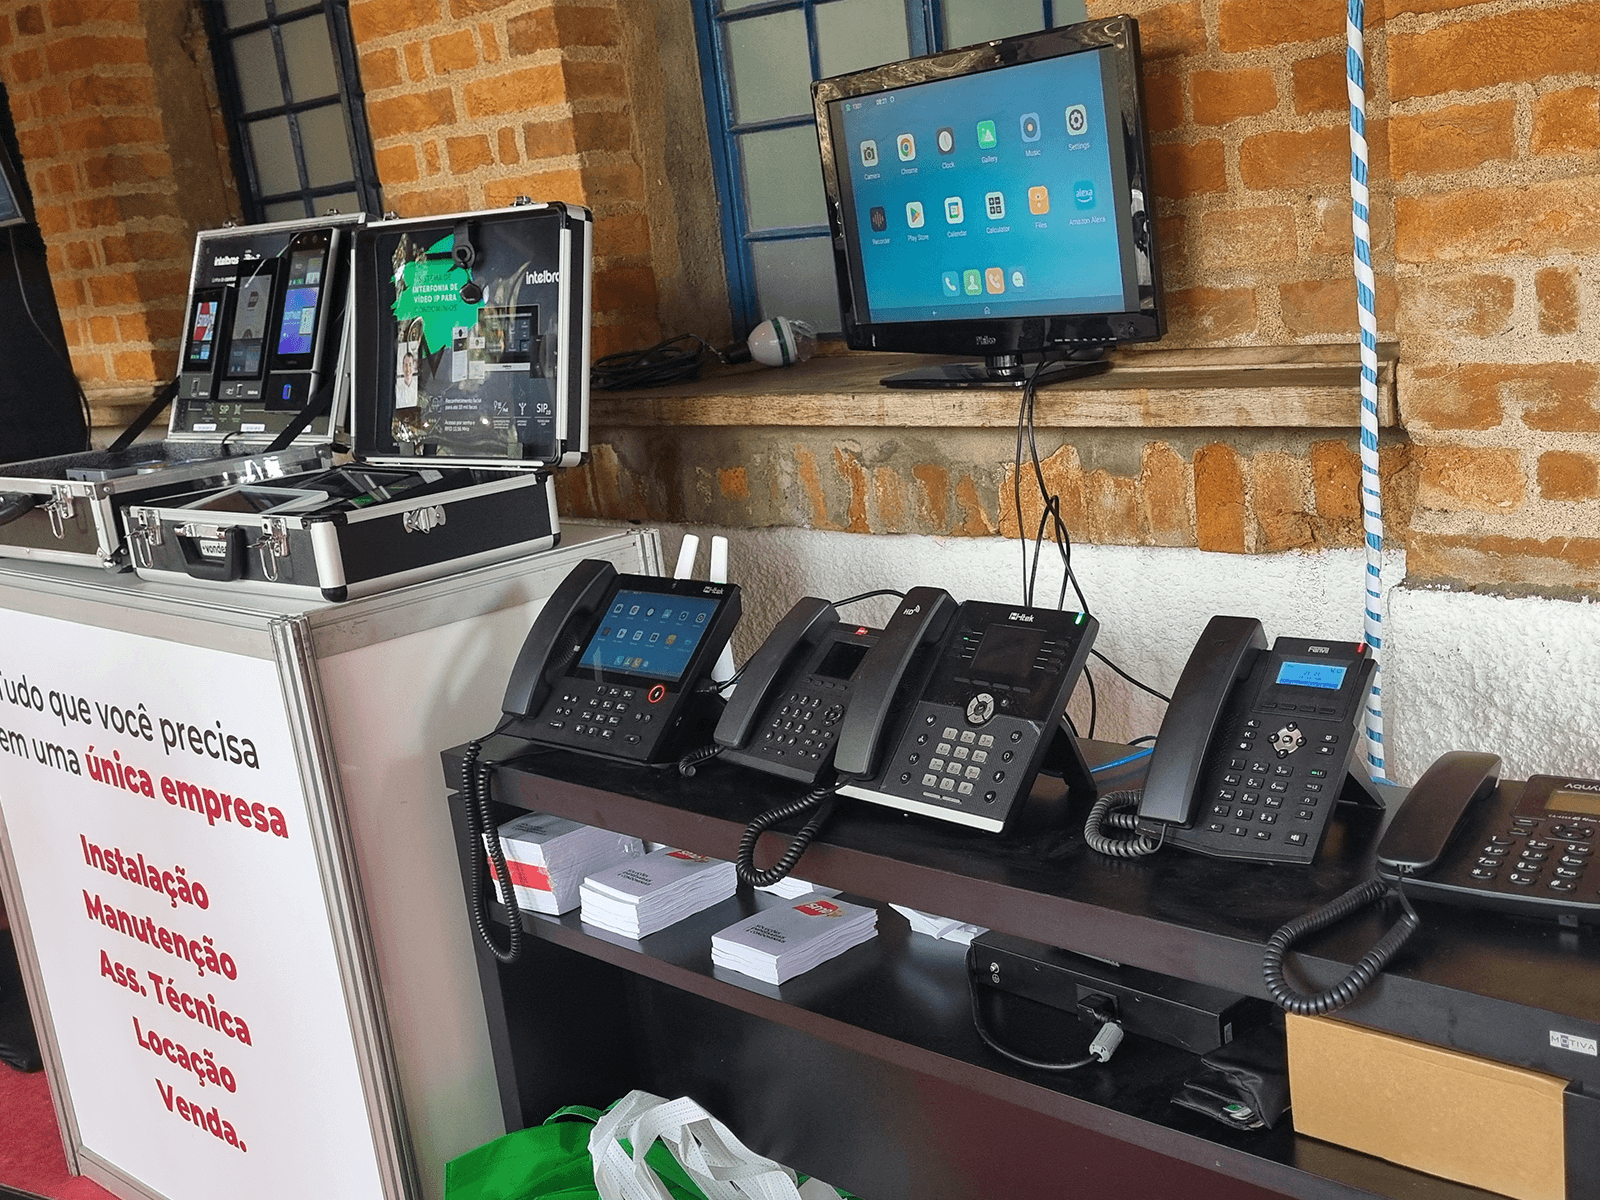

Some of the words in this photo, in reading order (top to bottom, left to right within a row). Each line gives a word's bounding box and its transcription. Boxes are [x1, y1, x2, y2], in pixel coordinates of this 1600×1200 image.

[1068, 142, 1090, 151] Settings
[981, 156, 998, 164] Gallery
[1076, 188, 1093, 198] alexa
[947, 230, 967, 238] Calendar
[986, 226, 1010, 234] Calculator
[908, 234, 917, 242] Play
[412, 284, 448, 293] INTERFONIA
[450, 283, 458, 291] DE
[414, 294, 432, 303] VÍDEO
[536, 403, 548, 413] SIP
[49, 689, 92, 726] que
[96, 702, 153, 742] você
[159, 720, 260, 770] precisa
[0, 728, 28, 760] em
[32, 738, 82, 776] uma
[85, 745, 156, 799] única
[160, 774, 288, 838] empresa
[1564, 783, 1600, 791] AQUÁ
[80, 834, 210, 910] Instalação
[82, 889, 238, 981] Manutenção
[100, 949, 147, 998] Ass.
[148, 970, 252, 1046] Técnica
[132, 1015, 236, 1094] Locação
[155, 1078, 248, 1153] Venda.
